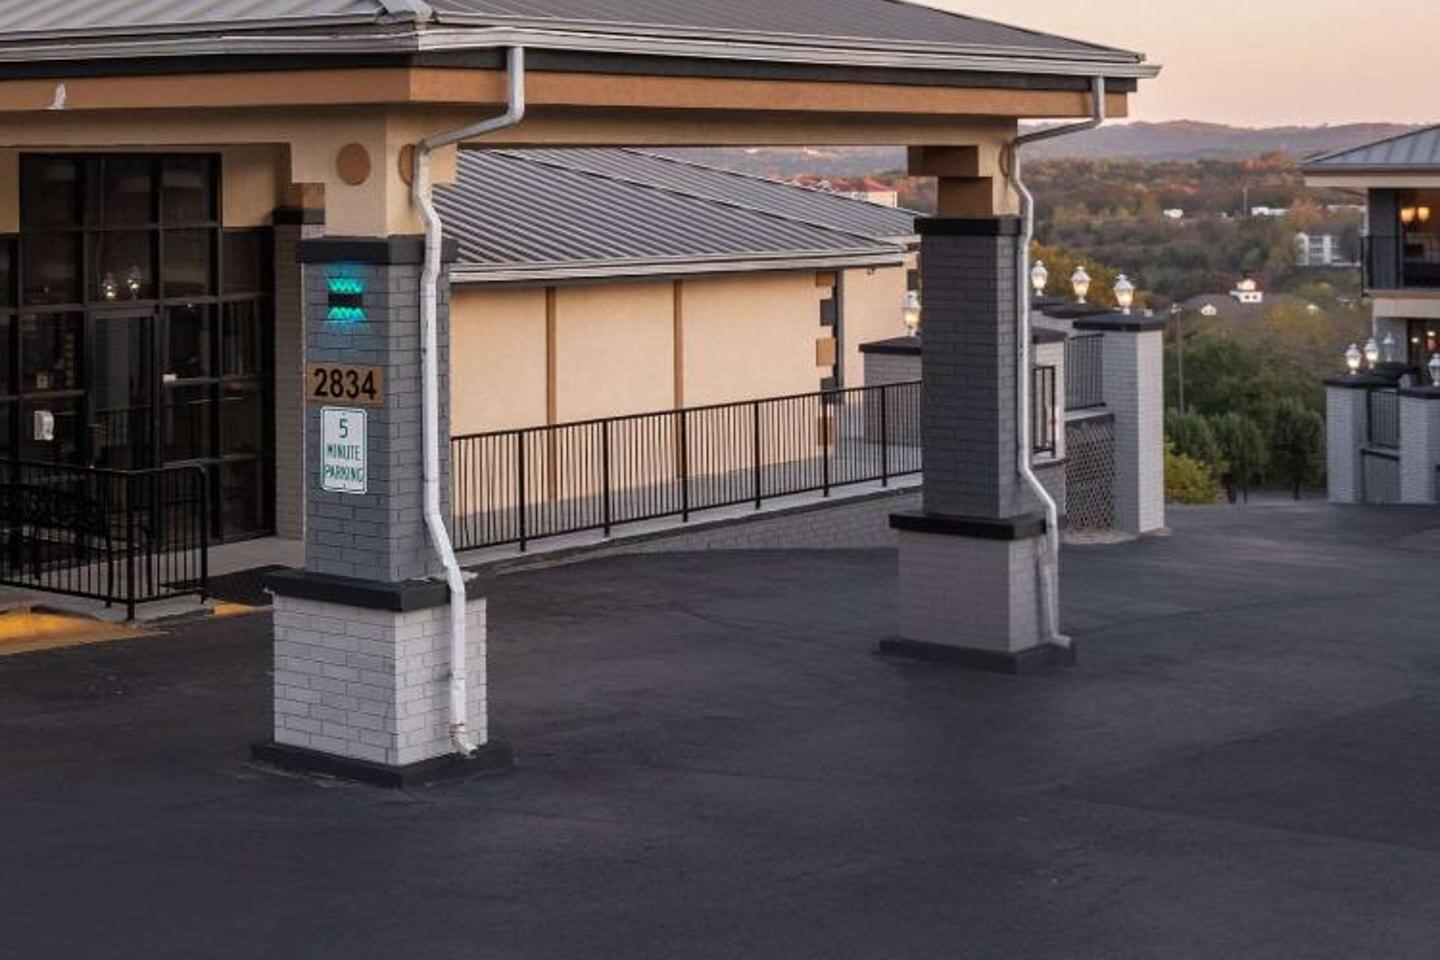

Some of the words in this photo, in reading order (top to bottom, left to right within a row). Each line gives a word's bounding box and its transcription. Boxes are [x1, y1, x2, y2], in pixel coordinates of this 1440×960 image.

[313, 368, 377, 400] 2834
[339, 419, 349, 438] 5
[327, 444, 361, 461] MINUTE
[324, 465, 364, 483] PARKING
